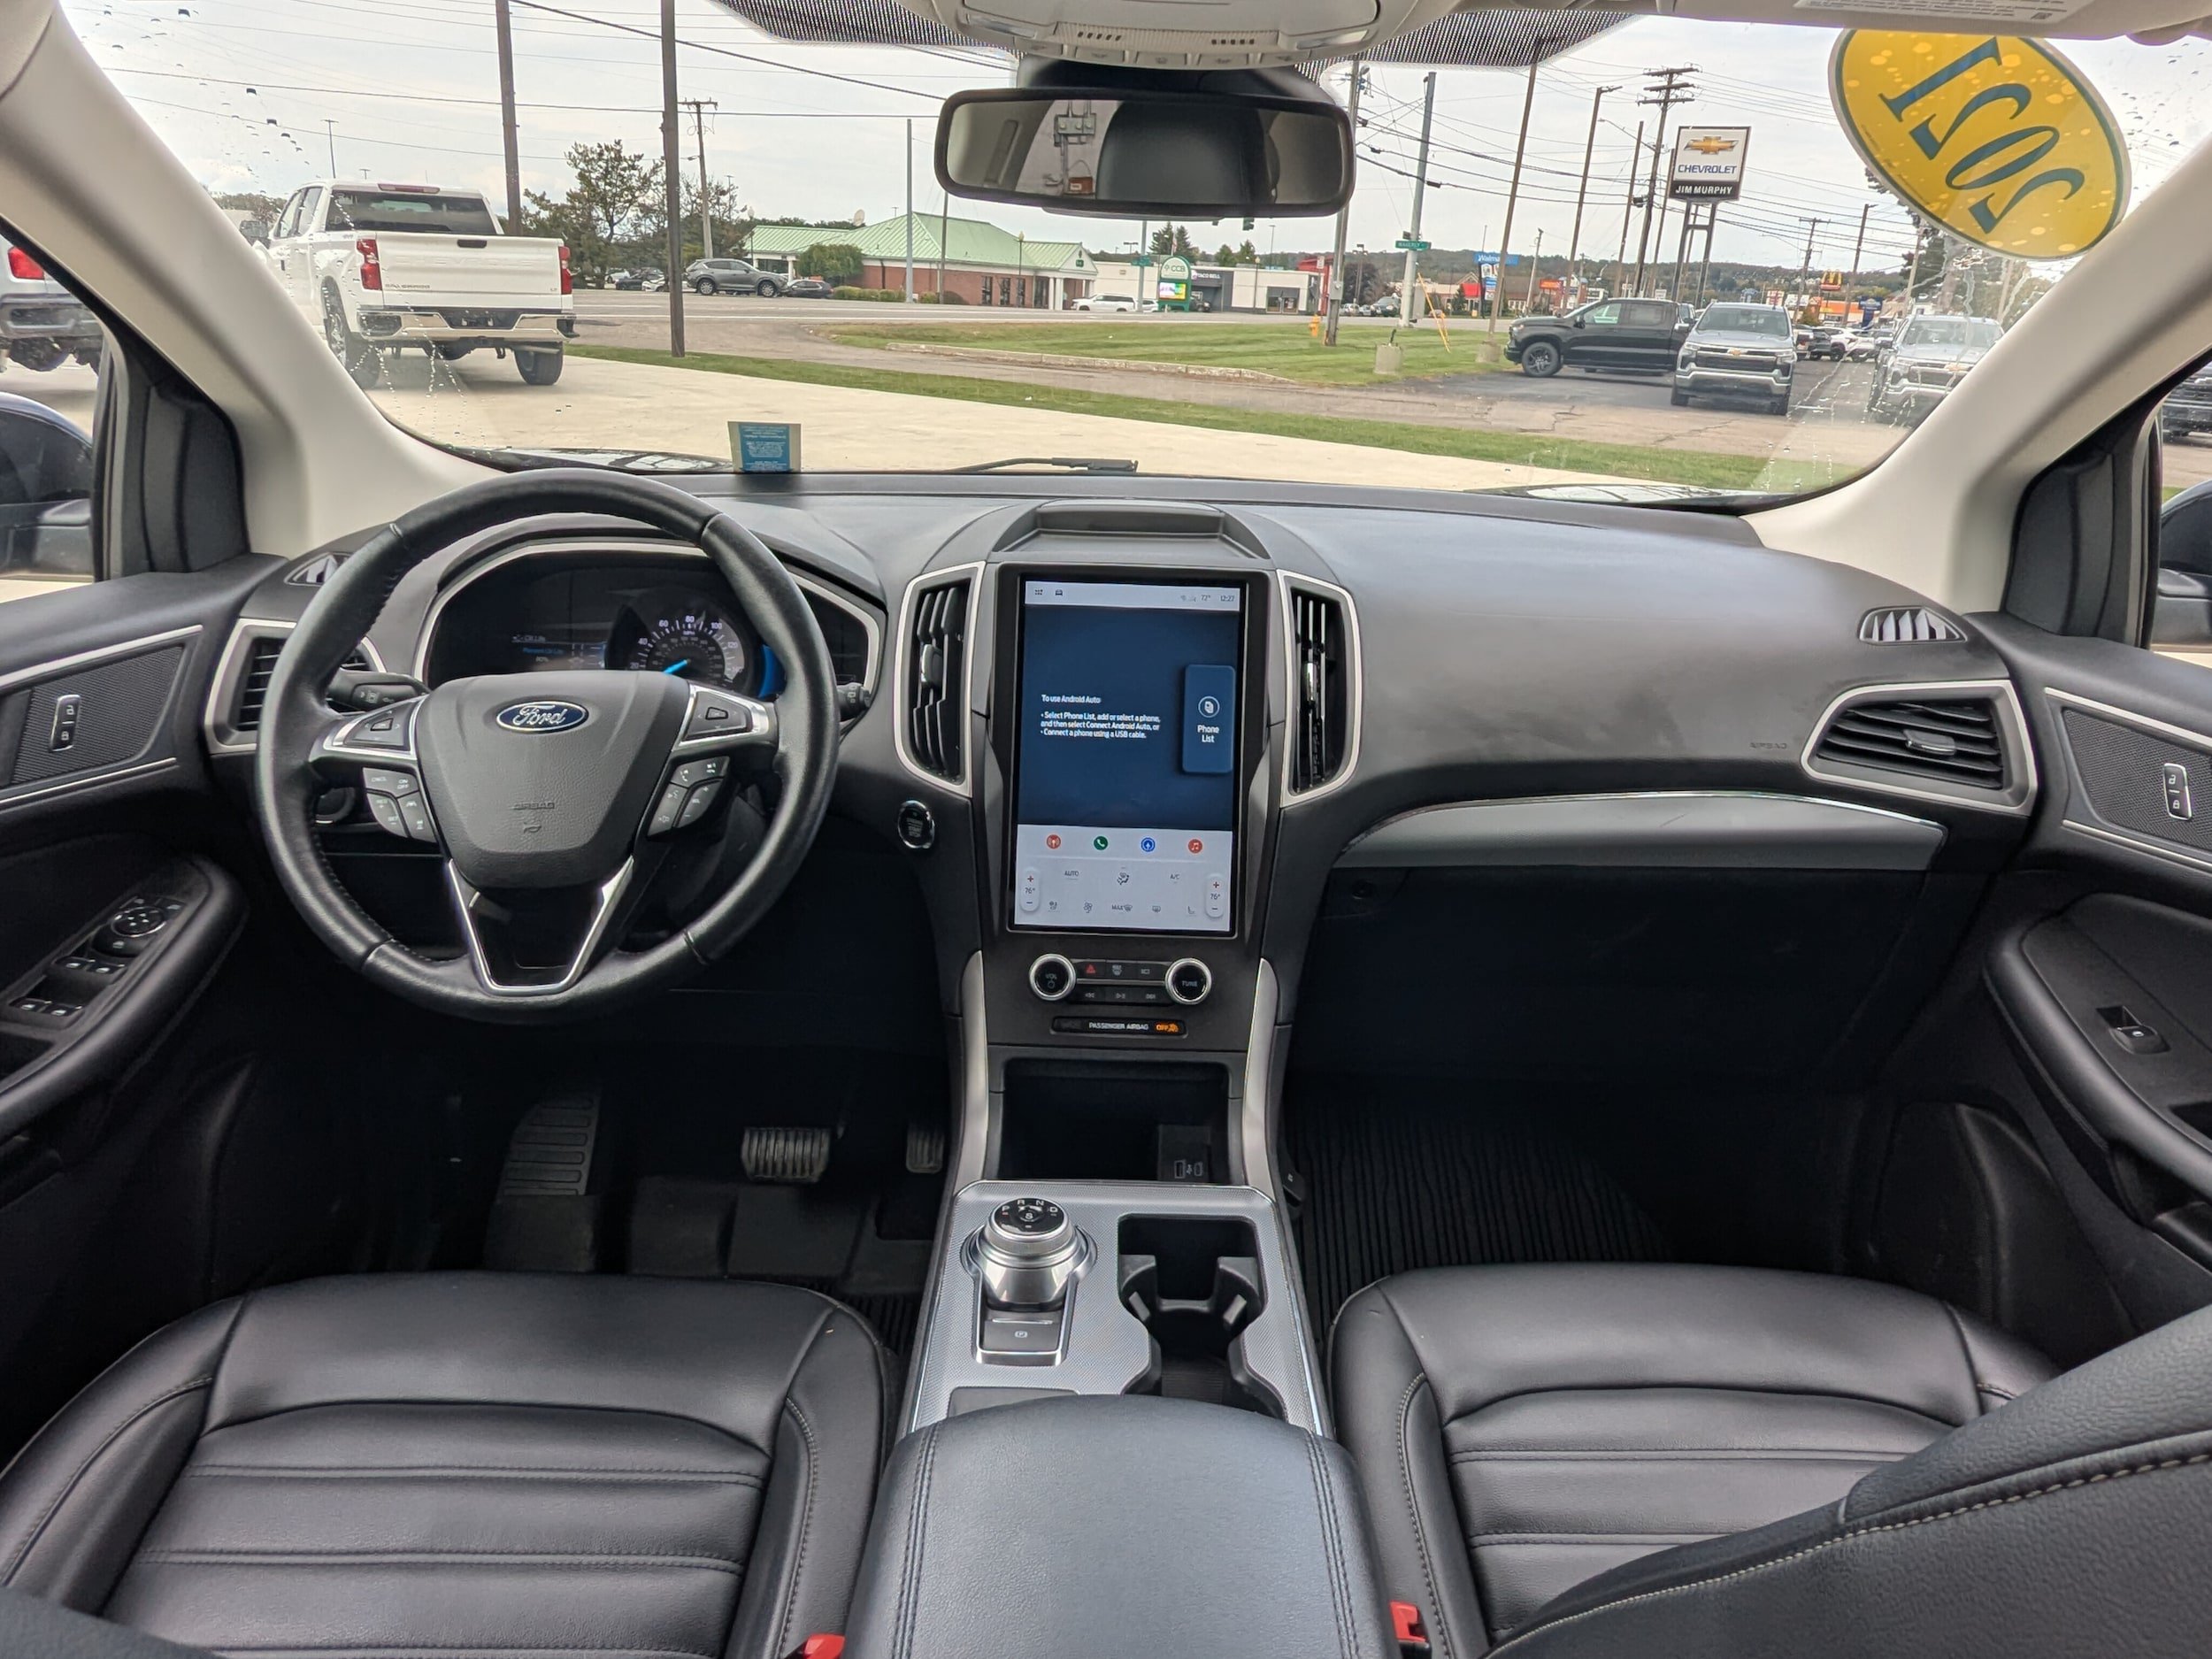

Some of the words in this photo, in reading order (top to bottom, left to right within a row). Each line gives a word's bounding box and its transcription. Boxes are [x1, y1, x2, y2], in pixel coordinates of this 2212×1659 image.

[1678, 165, 1737, 173] CHEVROLET
[1675, 185, 1693, 194] JIM
[512, 705, 568, 726] Ford
[1064, 711, 1084, 720] Phone
[1139, 714, 1161, 723] phone,
[1197, 724, 1220, 734] Phone
[1093, 730, 1110, 739] using
[1202, 733, 1215, 743] List
